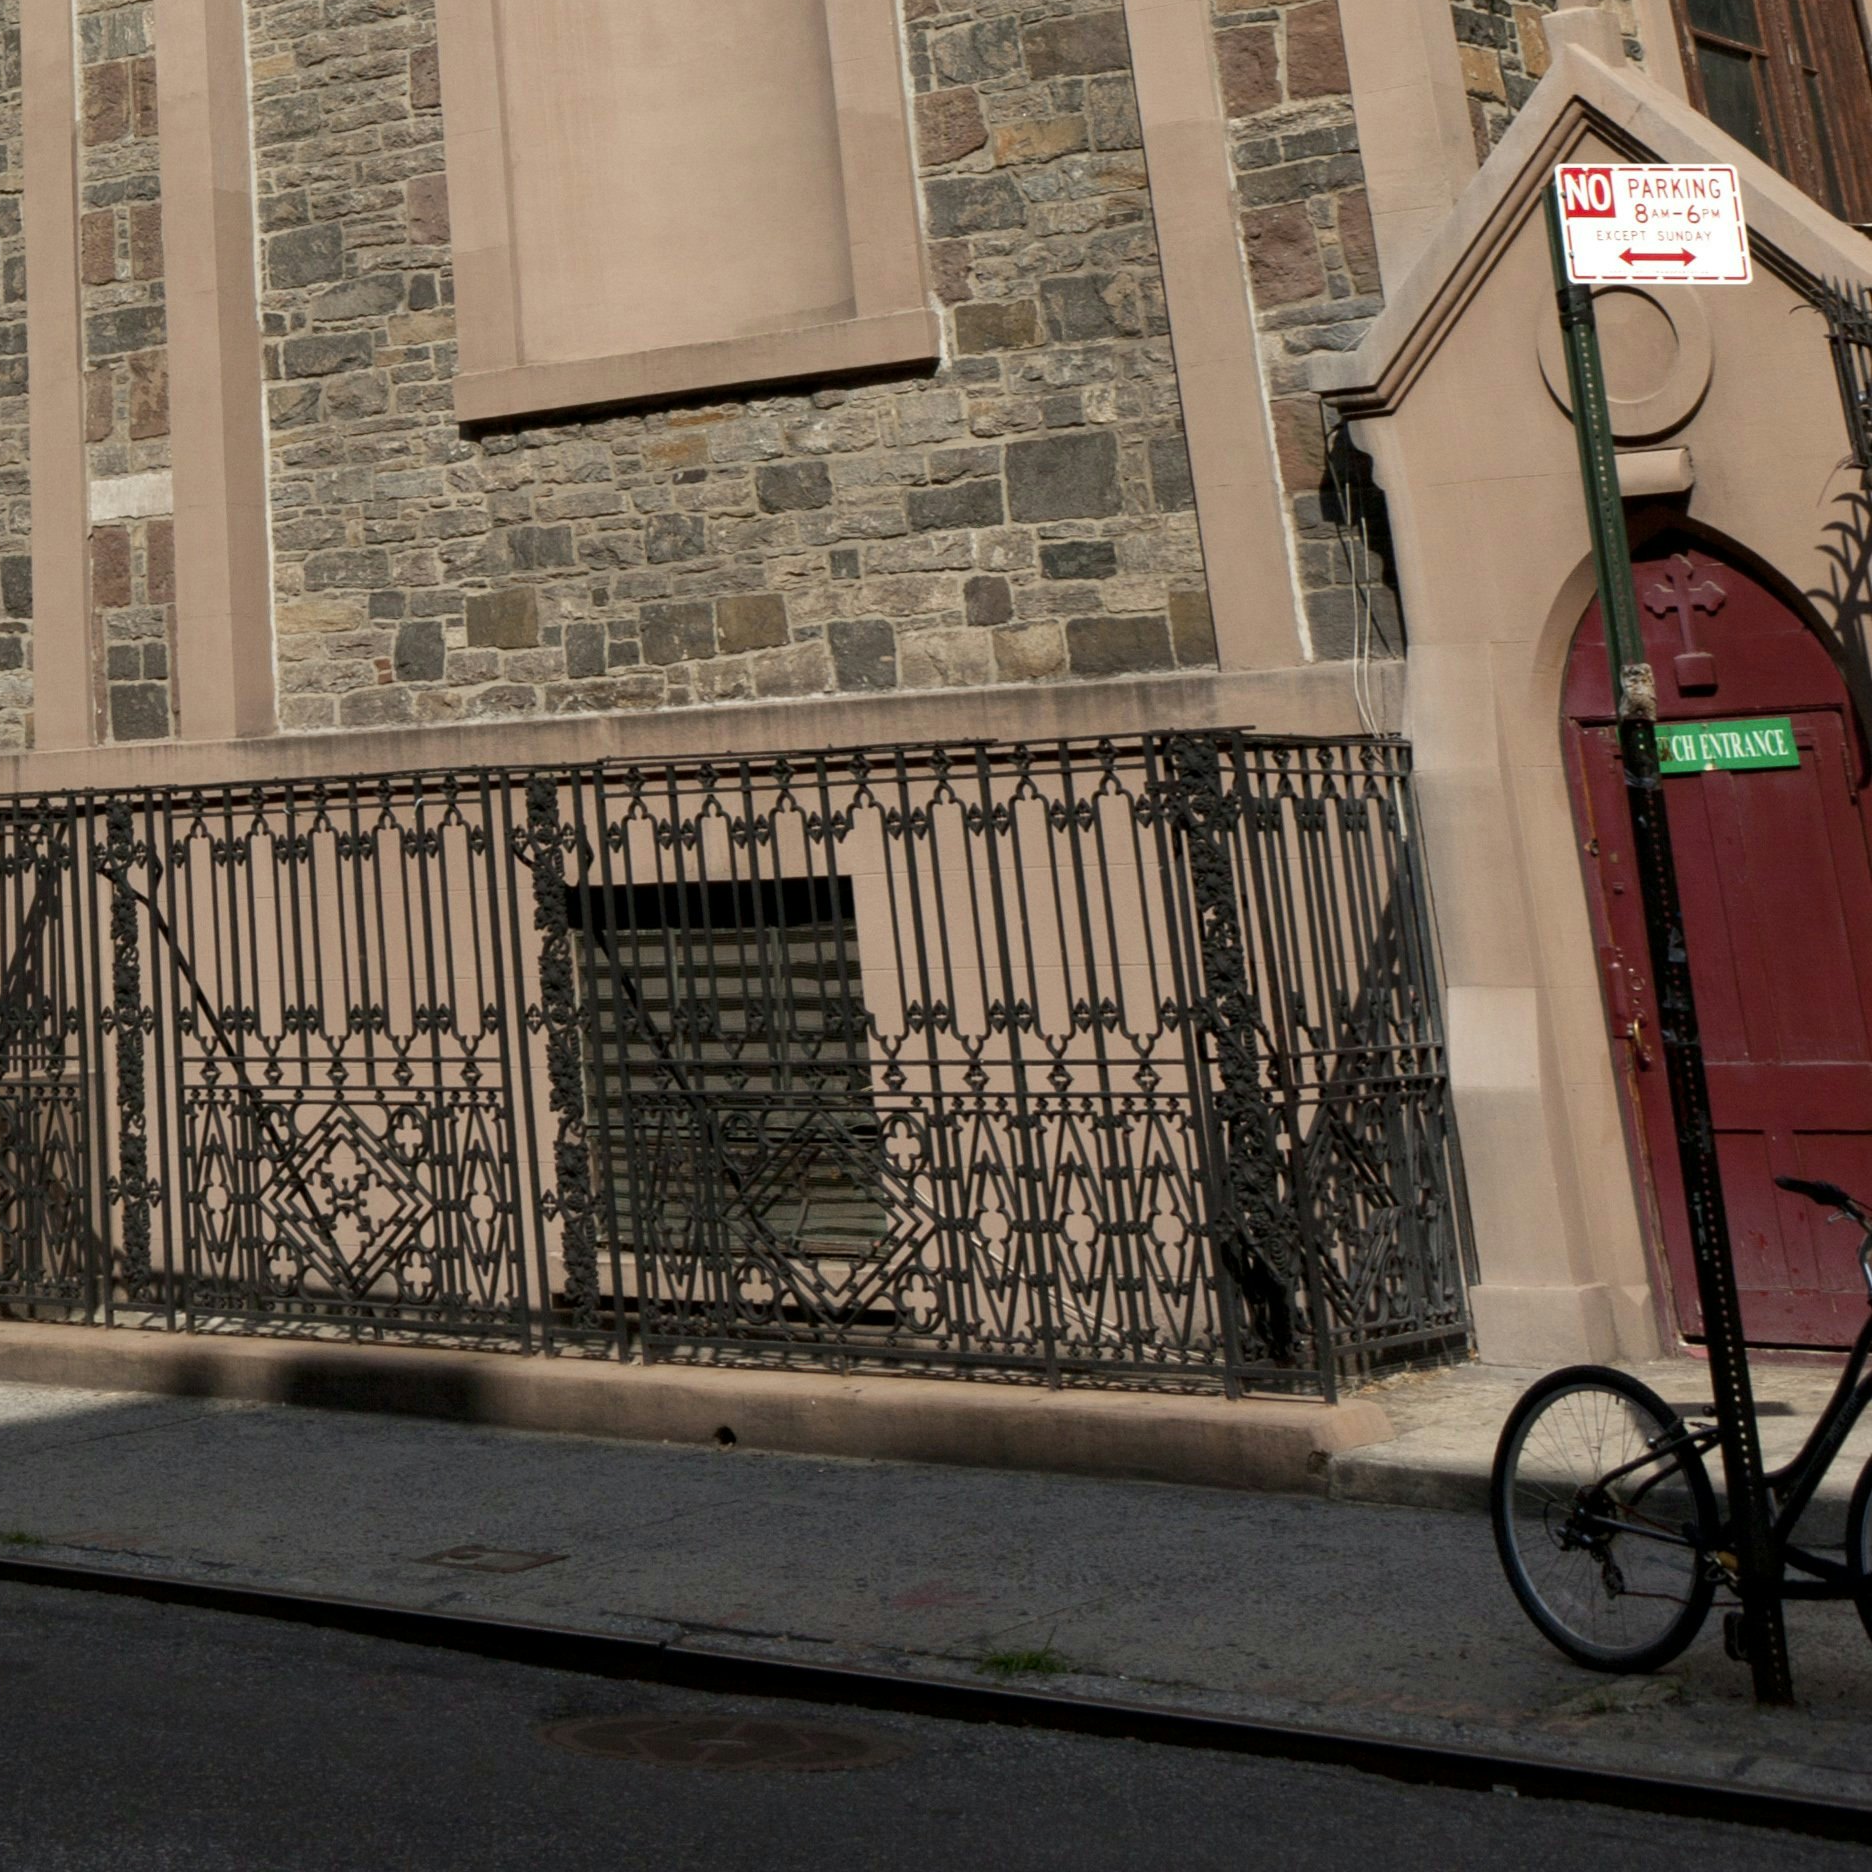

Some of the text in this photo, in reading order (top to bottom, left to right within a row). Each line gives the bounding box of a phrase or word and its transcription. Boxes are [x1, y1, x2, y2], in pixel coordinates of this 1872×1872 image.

[1564, 173, 1721, 212] NO PARKING
[1596, 230, 1712, 241] EXCEPT SUNDAY
[1698, 729, 1789, 760] ENTRANCE
